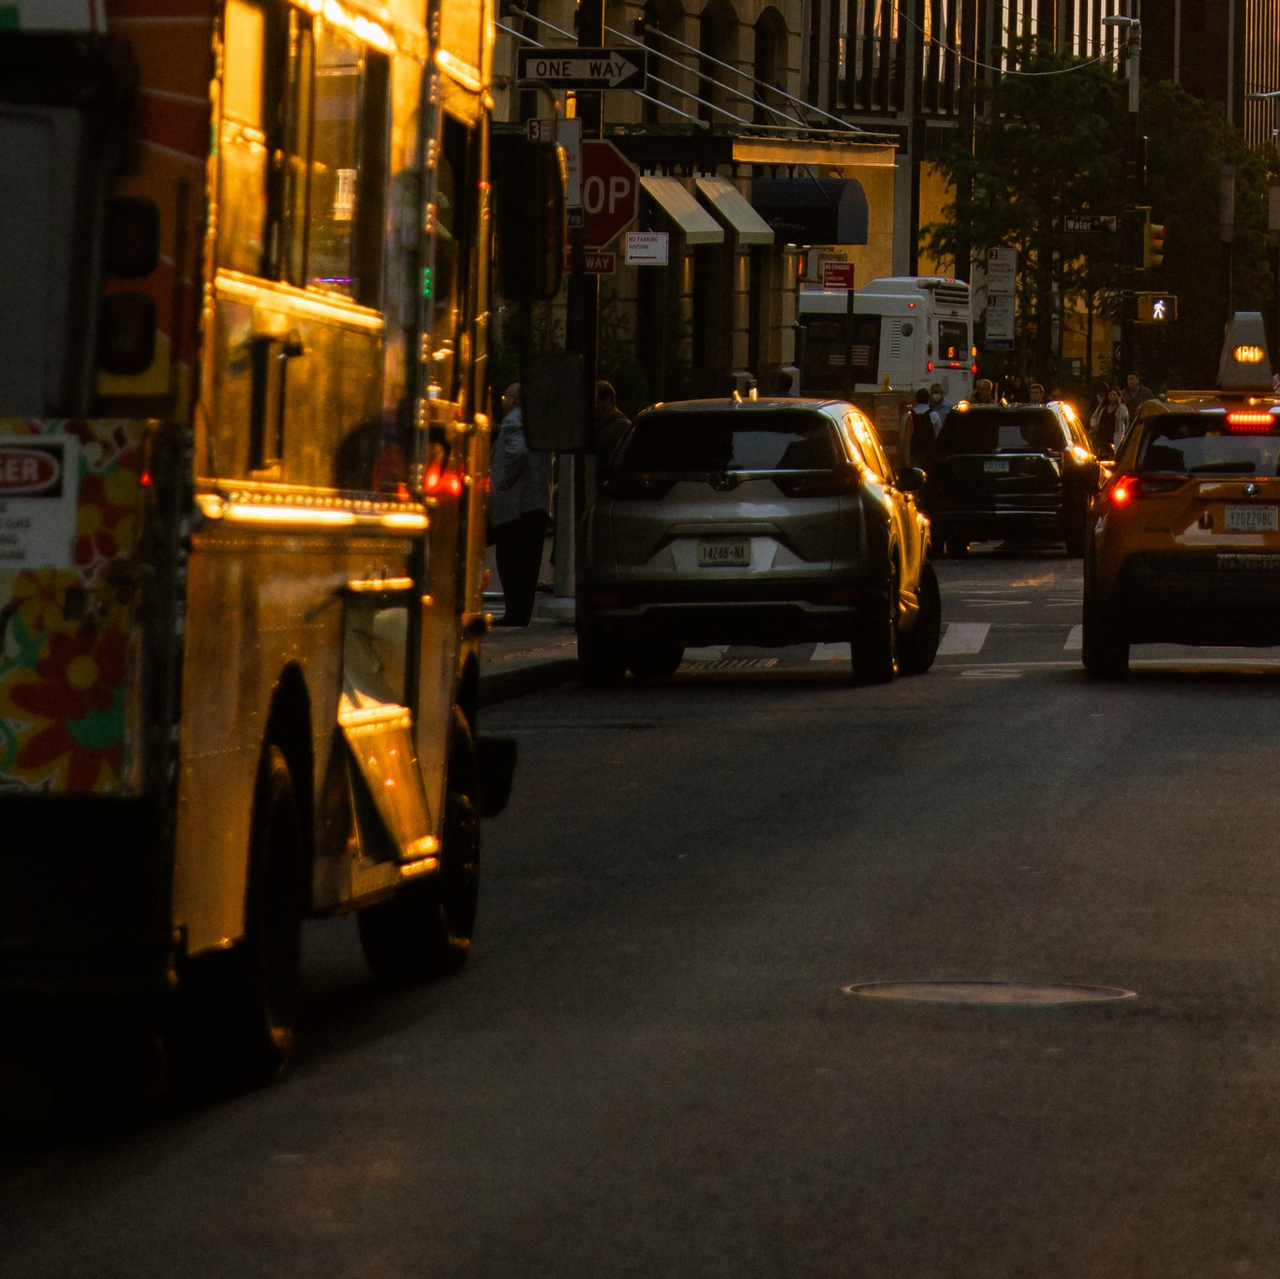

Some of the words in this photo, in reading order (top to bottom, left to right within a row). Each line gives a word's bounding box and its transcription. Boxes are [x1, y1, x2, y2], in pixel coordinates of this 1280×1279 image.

[536, 61, 571, 77] ONE
[589, 62, 626, 77] WAY
[530, 121, 540, 140] 3
[583, 175, 631, 214] OP
[1067, 219, 1092, 230] Water
[585, 256, 610, 269] WAY
[0, 459, 39, 482] ER
